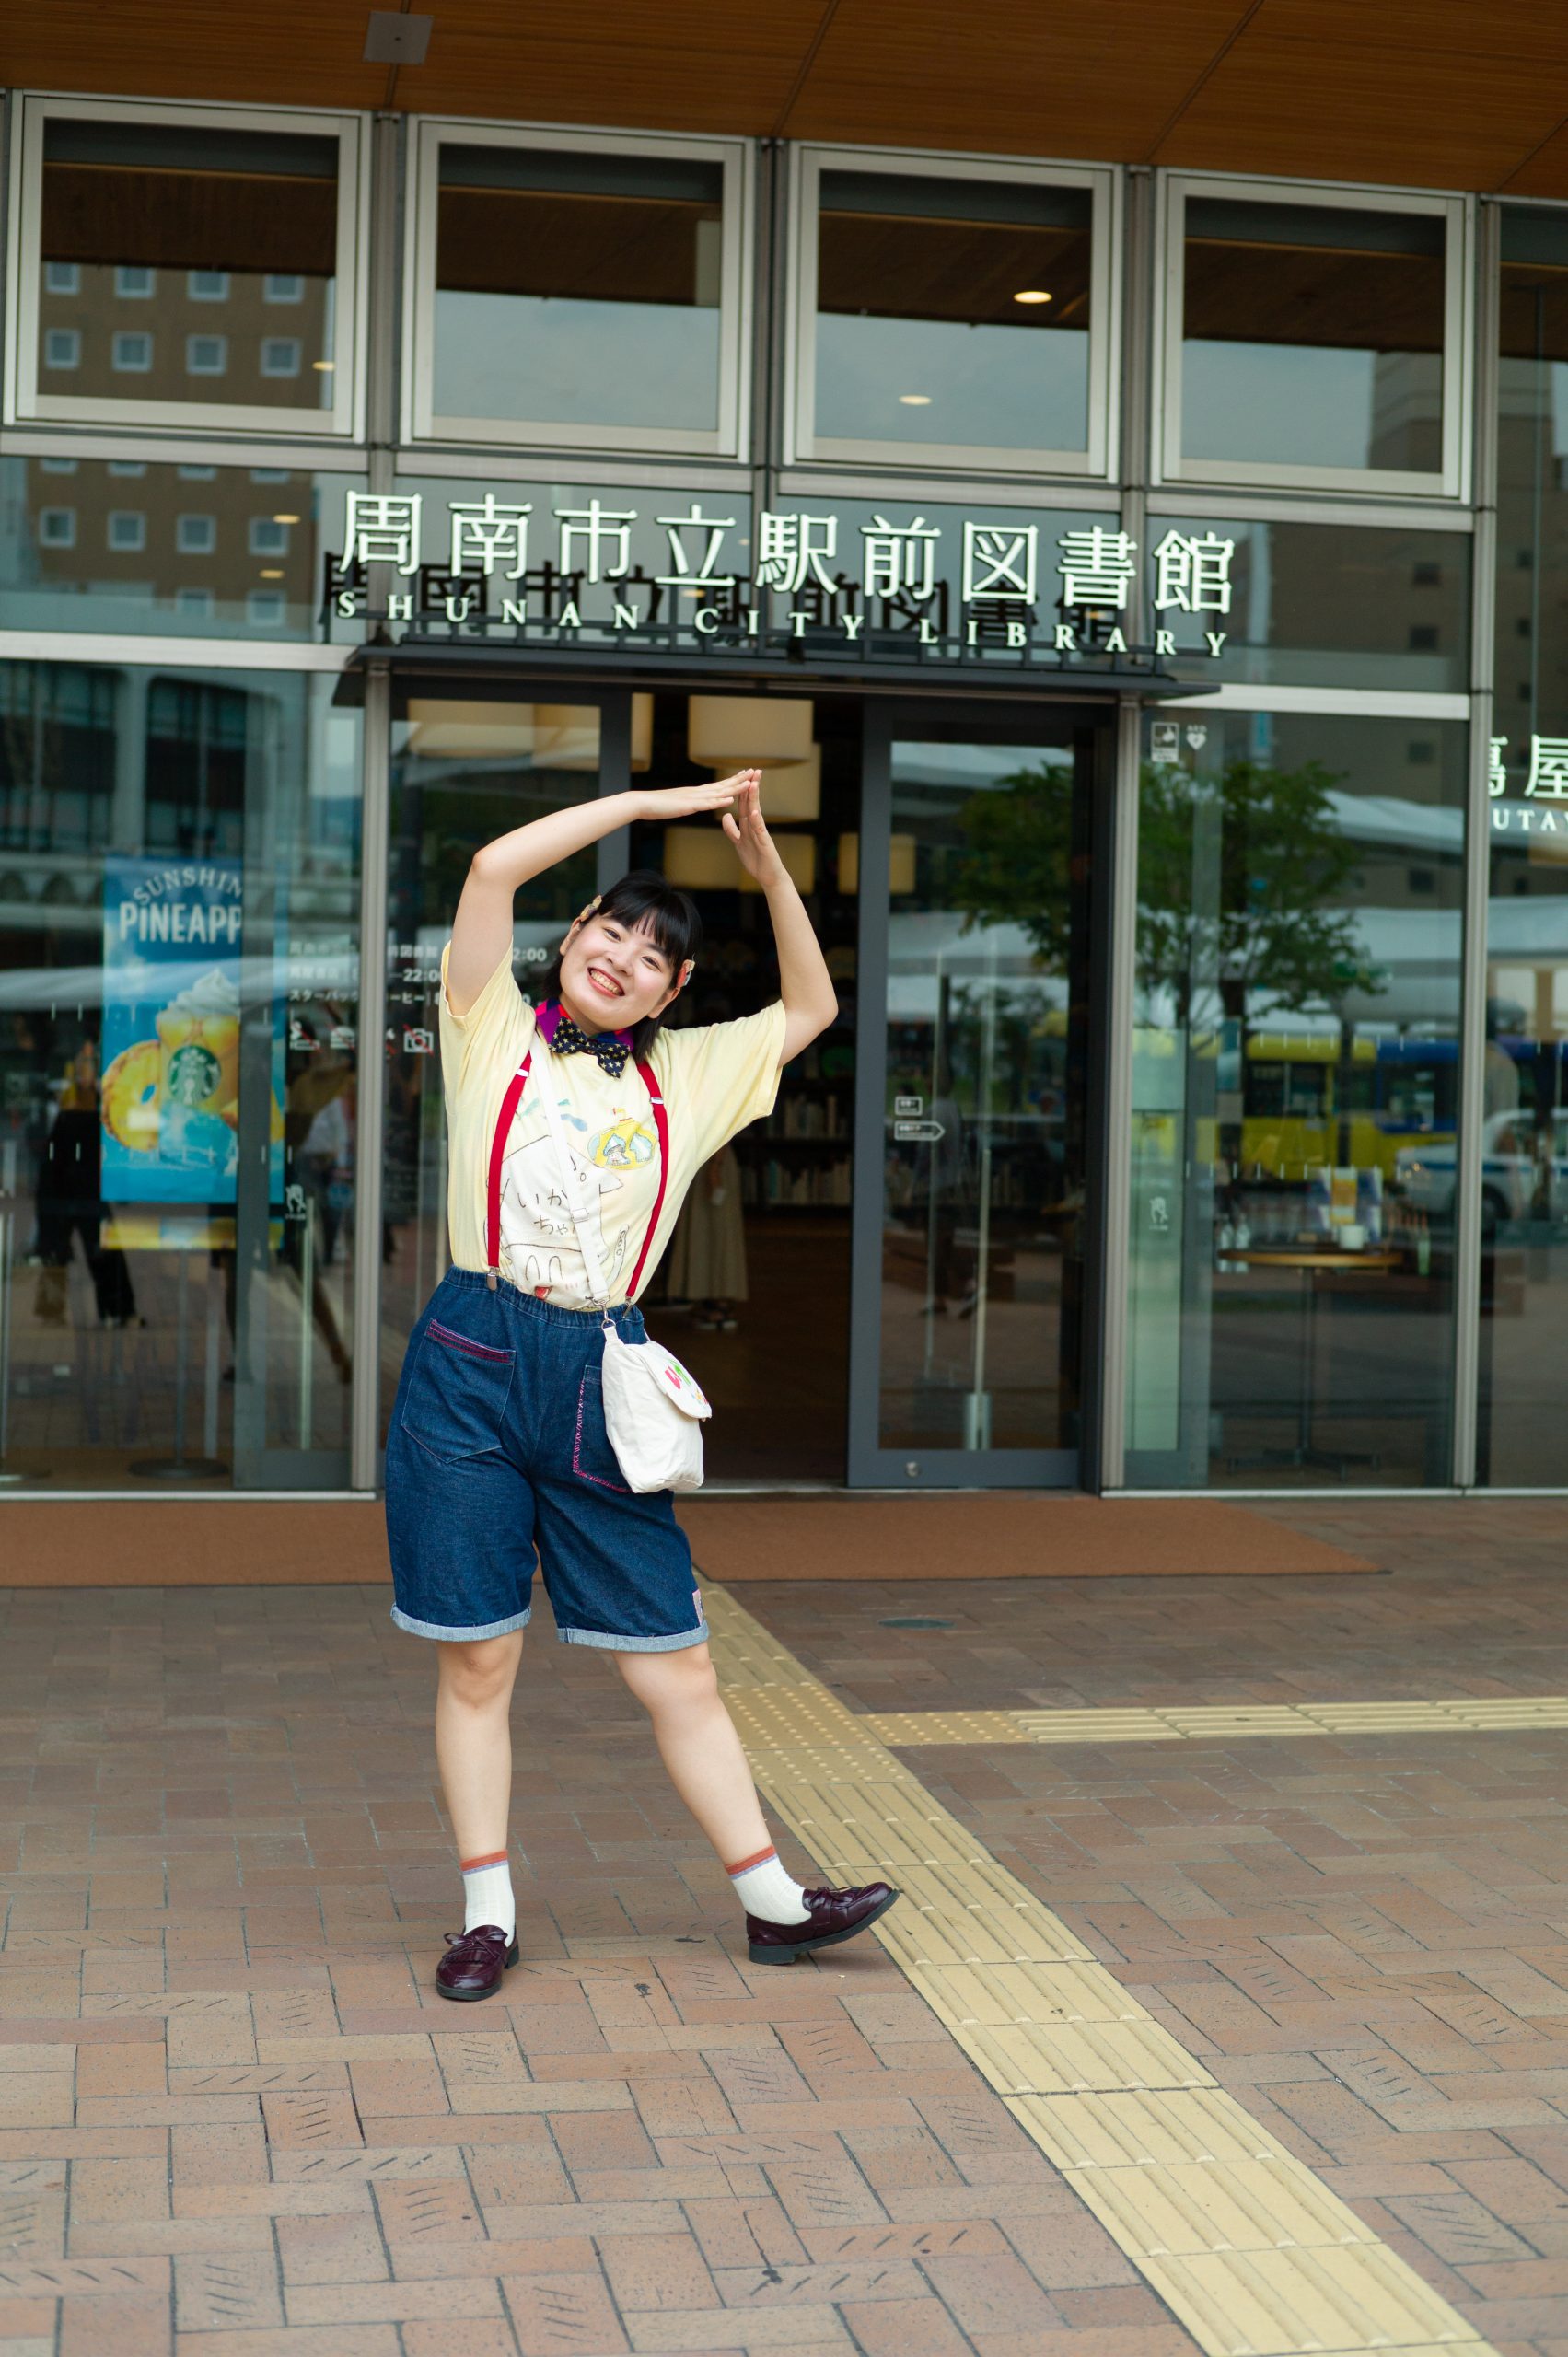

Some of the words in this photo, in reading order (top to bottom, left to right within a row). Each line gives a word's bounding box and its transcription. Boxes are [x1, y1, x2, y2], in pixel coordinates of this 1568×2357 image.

[339, 489, 1236, 615] 周南市立駅前図書館
[337, 591, 640, 631] SHUNAN
[692, 608, 865, 641] CITY
[919, 618, 1228, 657] LIBRARY
[533, 1214, 576, 1236] ちゃ
